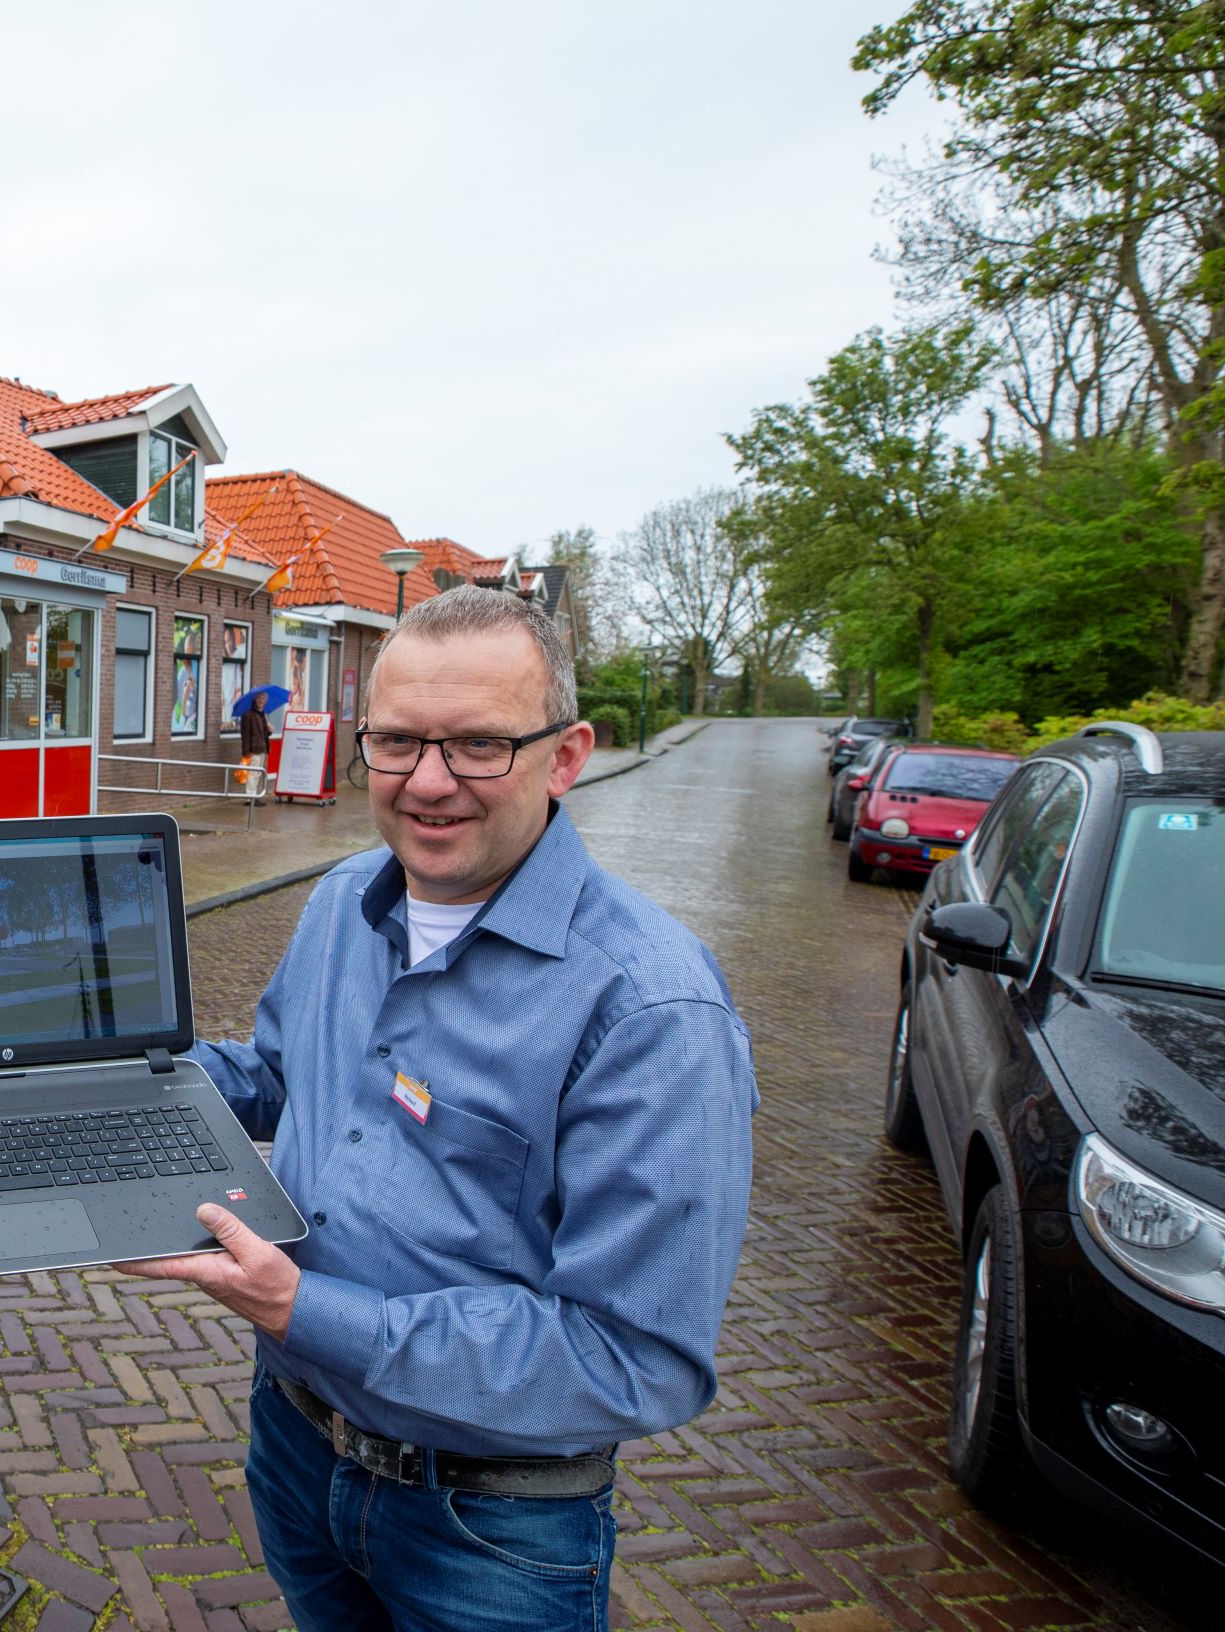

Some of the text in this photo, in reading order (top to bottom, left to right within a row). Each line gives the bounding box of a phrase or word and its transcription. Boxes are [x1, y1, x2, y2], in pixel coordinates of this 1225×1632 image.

[15, 556, 106, 588] coop Gerritsma
[296, 715, 323, 725] coop
